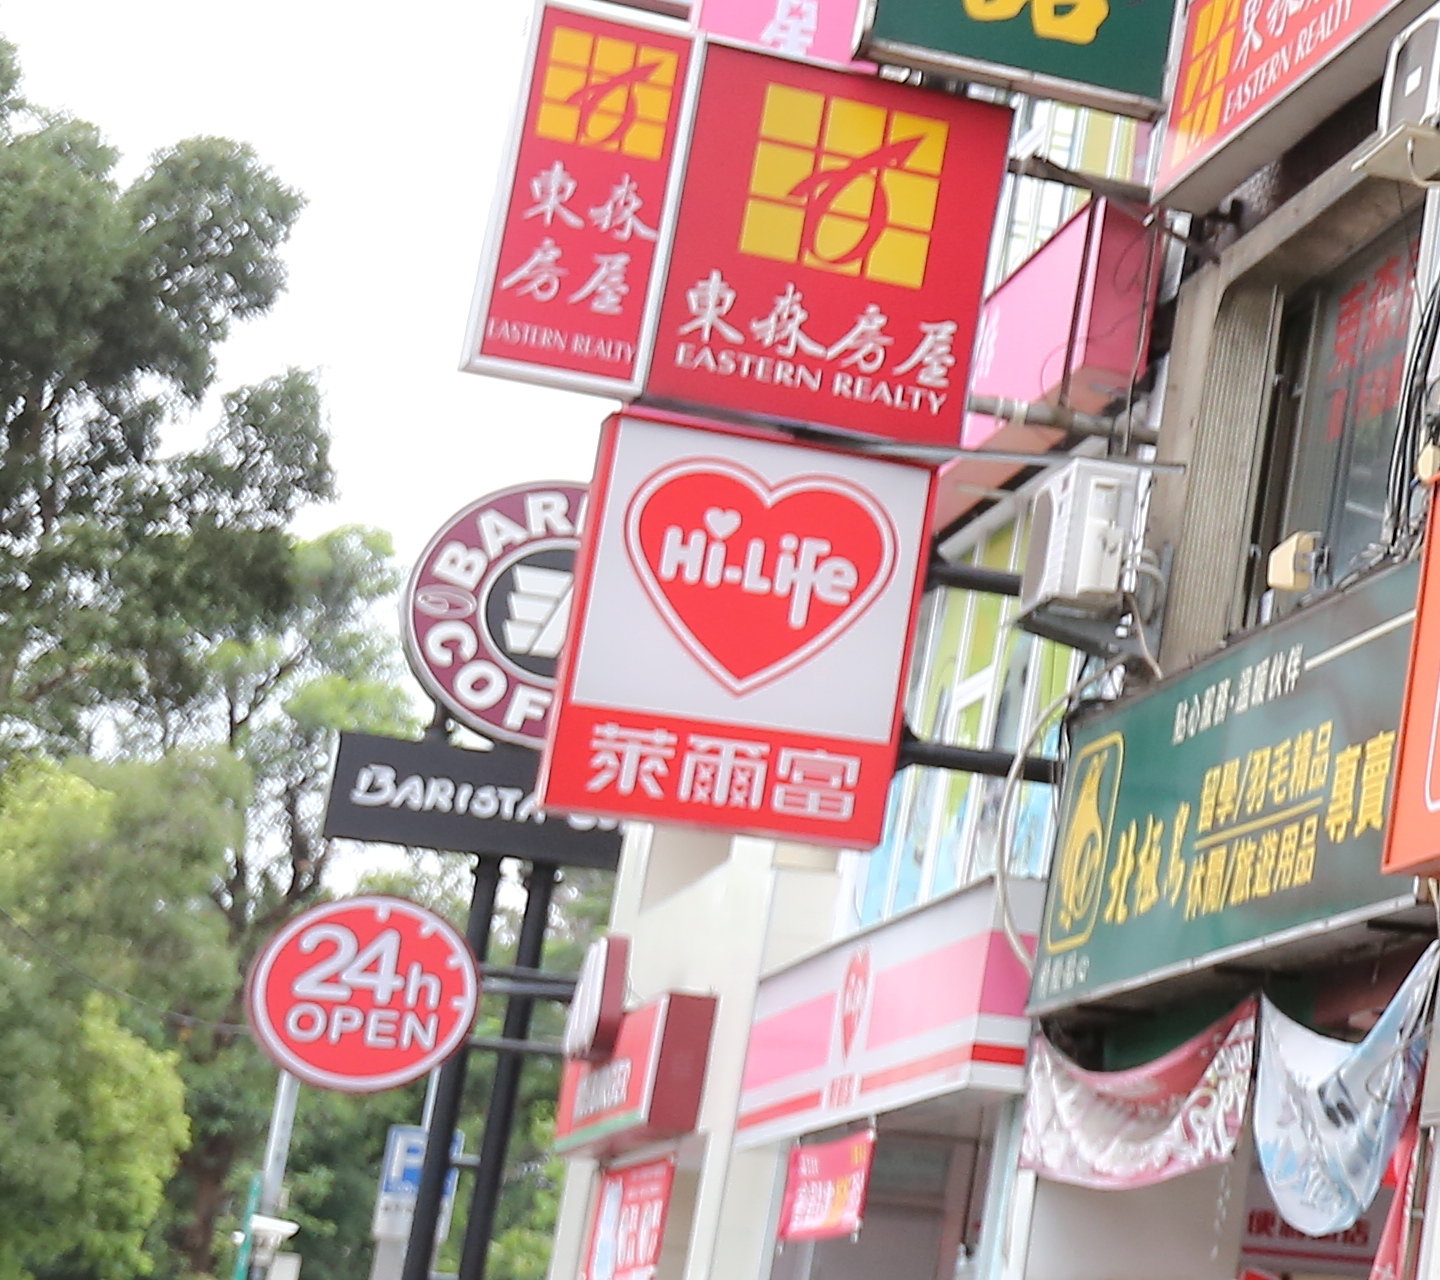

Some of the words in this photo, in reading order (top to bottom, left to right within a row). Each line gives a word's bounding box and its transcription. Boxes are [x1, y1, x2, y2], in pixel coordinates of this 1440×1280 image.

[1222, 54, 1293, 122] EASTERN
[521, 160, 657, 245] 東森
[504, 237, 631, 316] 房屋
[488, 315, 567, 353] EASTERN
[571, 330, 636, 364] REALTY
[678, 270, 959, 392] 東森房屋
[676, 344, 822, 390] EASTERN
[832, 371, 947, 416] REALTY
[586, 723, 860, 820] 萊爾富
[1325, 730, 1396, 844] 專賣
[292, 926, 441, 1008] 24h
[286, 1004, 439, 1052] OPEN
